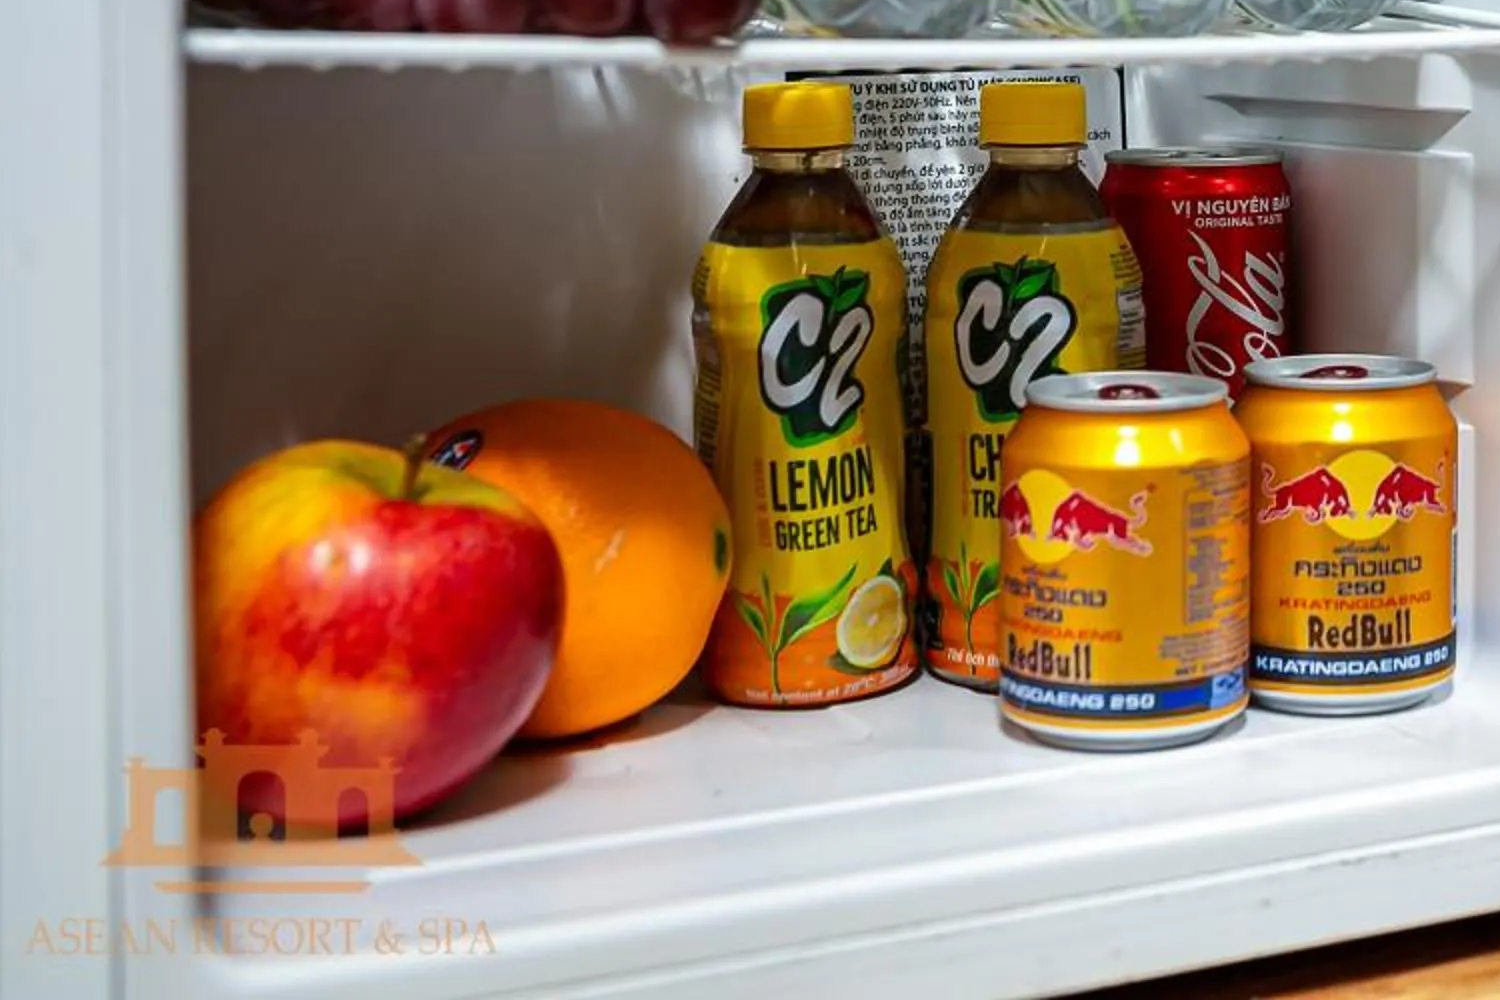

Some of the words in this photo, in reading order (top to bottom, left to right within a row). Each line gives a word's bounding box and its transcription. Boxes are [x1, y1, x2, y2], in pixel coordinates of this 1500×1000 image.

[875, 83, 897, 95] KHI
[959, 162, 966, 175] 2
[1170, 199, 1192, 219] VỊ
[1196, 195, 1270, 216] NGUYÊN
[1194, 215, 1255, 229] ORIGINAL
[759, 290, 875, 428] C2
[956, 278, 1072, 410] C2
[769, 445, 876, 513] LEMON
[970, 488, 1000, 519] TR
[774, 511, 841, 552] GREEN
[845, 502, 878, 540] TEA
[1336, 579, 1386, 597] 250
[1307, 608, 1412, 649] RedBull
[1007, 631, 1092, 681] RedBull
[1256, 654, 1421, 676] KRATINGDAENG
[1424, 644, 1449, 666] 250
[1109, 691, 1156, 711] 250
